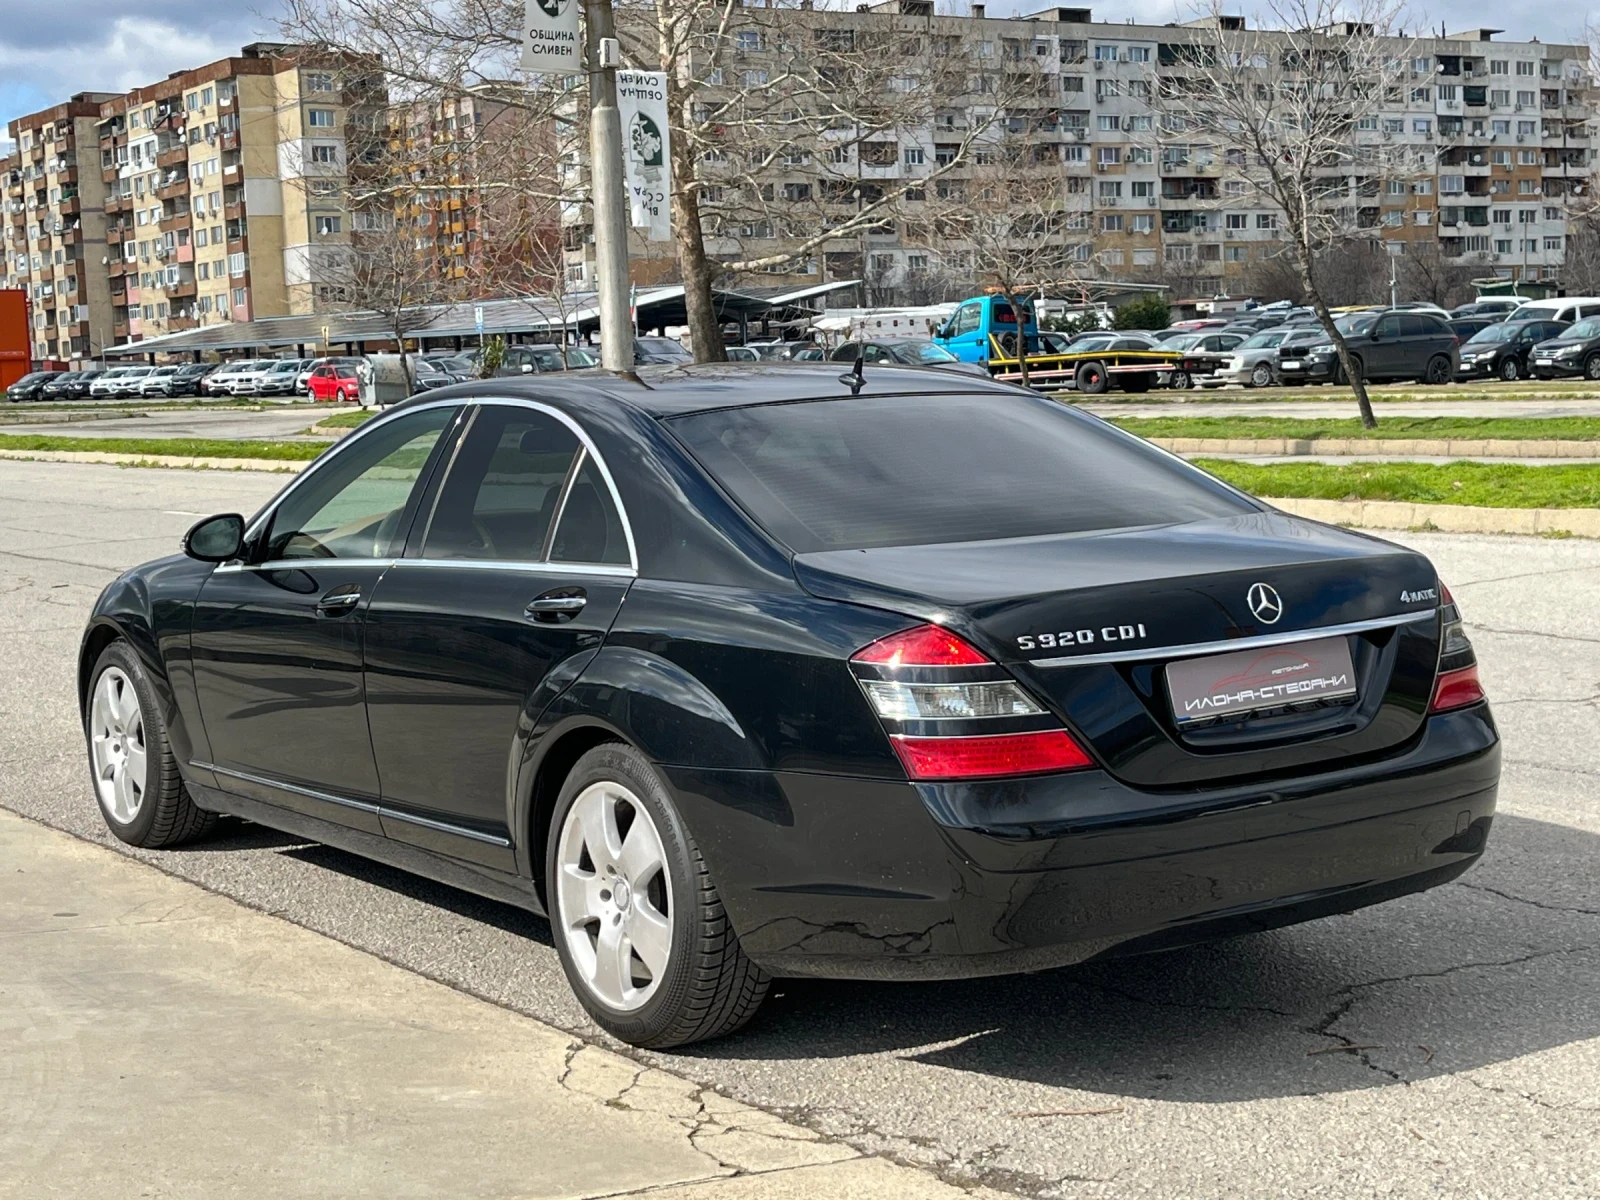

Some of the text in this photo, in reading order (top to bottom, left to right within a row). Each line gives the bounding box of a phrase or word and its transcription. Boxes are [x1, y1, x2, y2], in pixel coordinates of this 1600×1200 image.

[529, 29, 575, 41] ОБЩИНА
[532, 43, 572, 56] СЛИВЕН
[619, 73, 659, 87] СЛИЕН
[1100, 623, 1147, 642] CDI
[1184, 674, 1347, 711] ИЛОНА-СТЕФАНИ
[654, 797, 673, 833] 235/50
